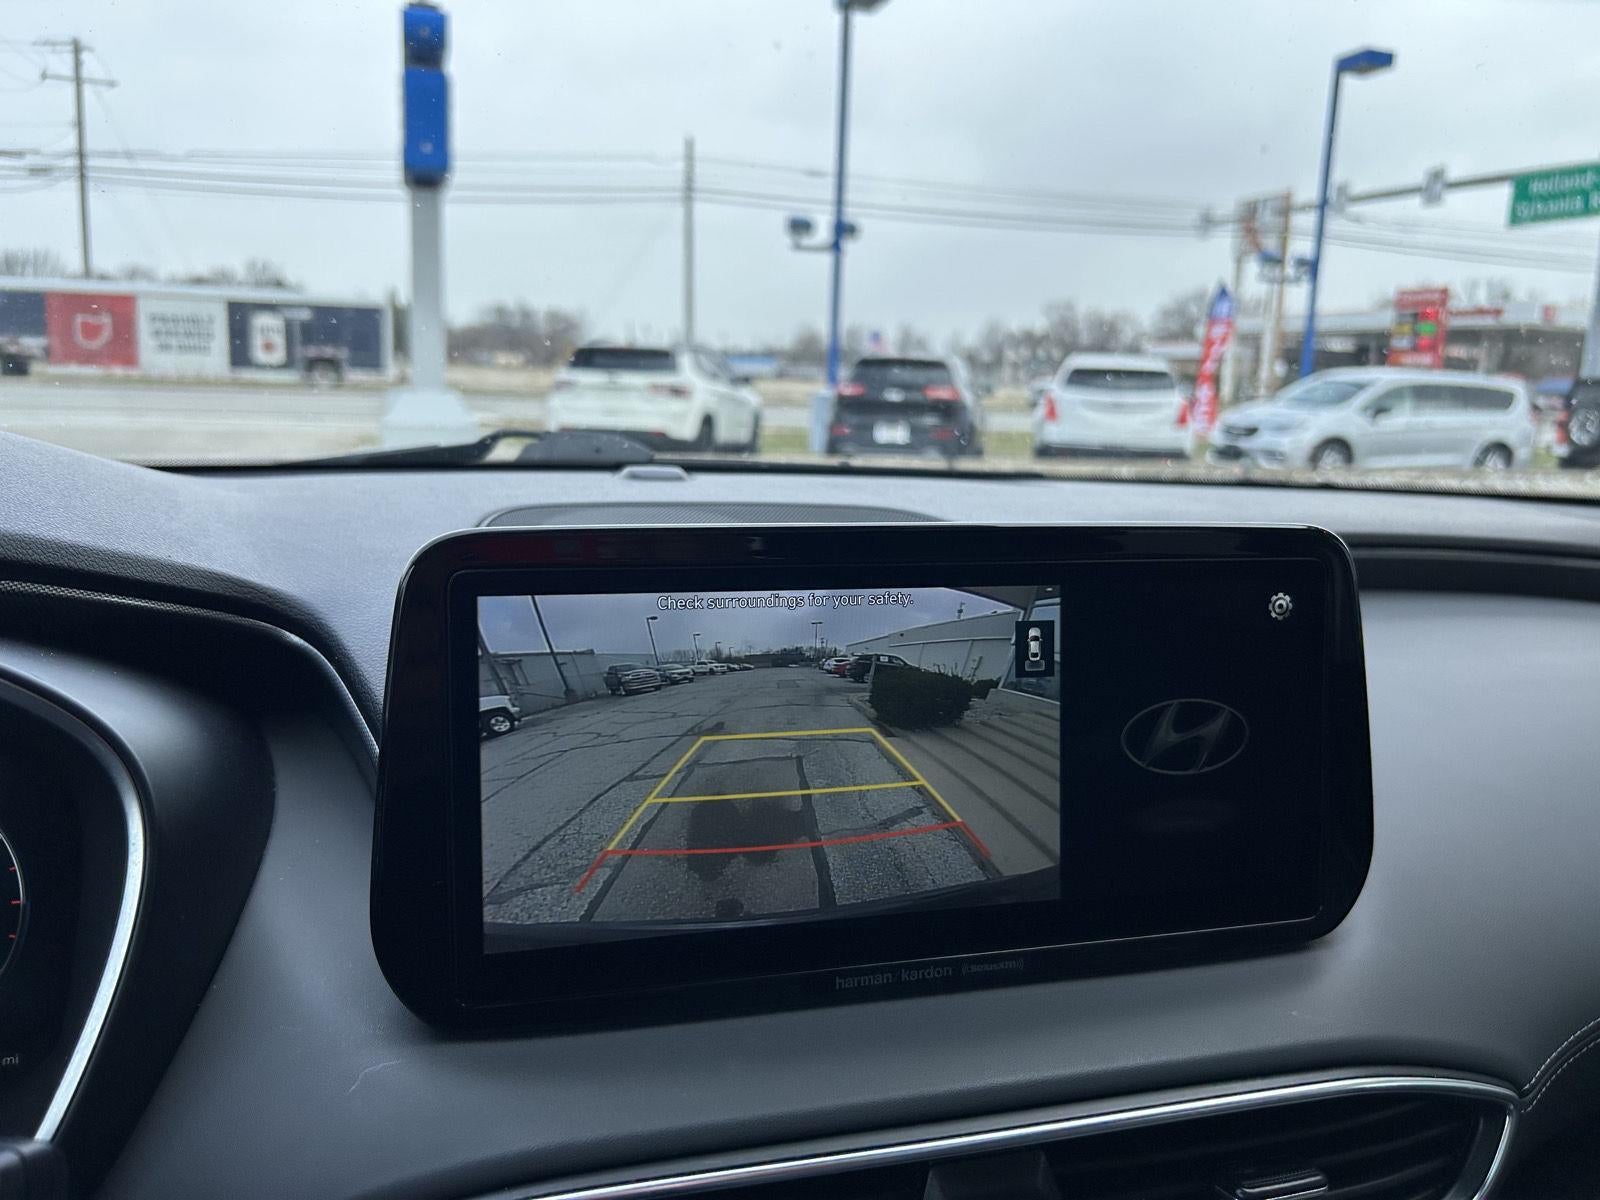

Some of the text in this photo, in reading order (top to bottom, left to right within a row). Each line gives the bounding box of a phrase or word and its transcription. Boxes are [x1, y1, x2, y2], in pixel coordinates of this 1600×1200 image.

[657, 591, 914, 611] Check surroundings for your safety.
[835, 971, 893, 990] harman
[901, 965, 952, 983] kardon
[2, 1053, 19, 1066] mi
